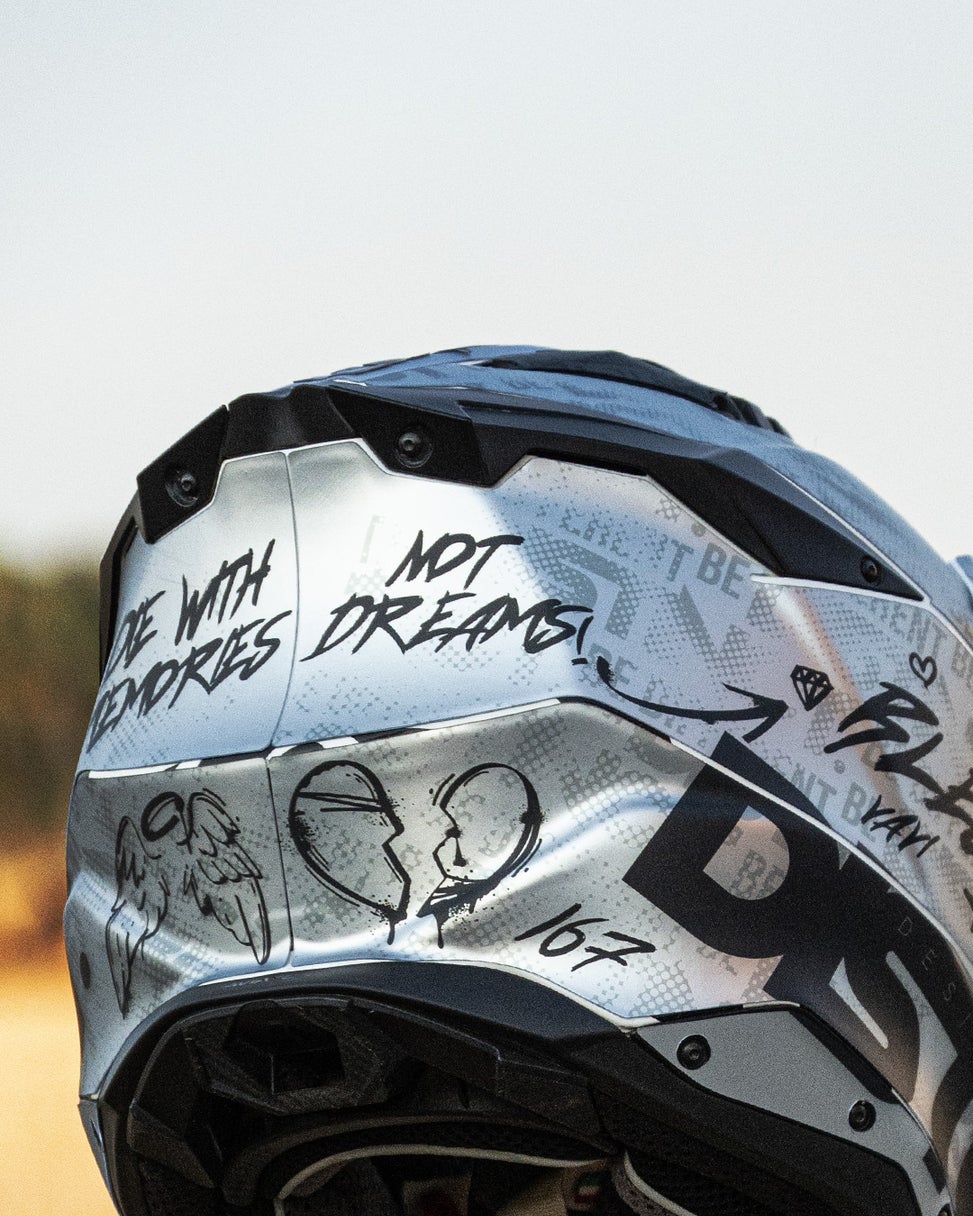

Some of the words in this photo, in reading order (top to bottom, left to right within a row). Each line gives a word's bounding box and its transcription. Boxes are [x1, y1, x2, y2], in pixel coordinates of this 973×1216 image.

[174, 538, 276, 647] WITH
[386, 529, 525, 589] NOT
[300, 590, 595, 667] DREAMS!
[87, 610, 292, 754] EMORIES
[515, 903, 656, 973] 167
